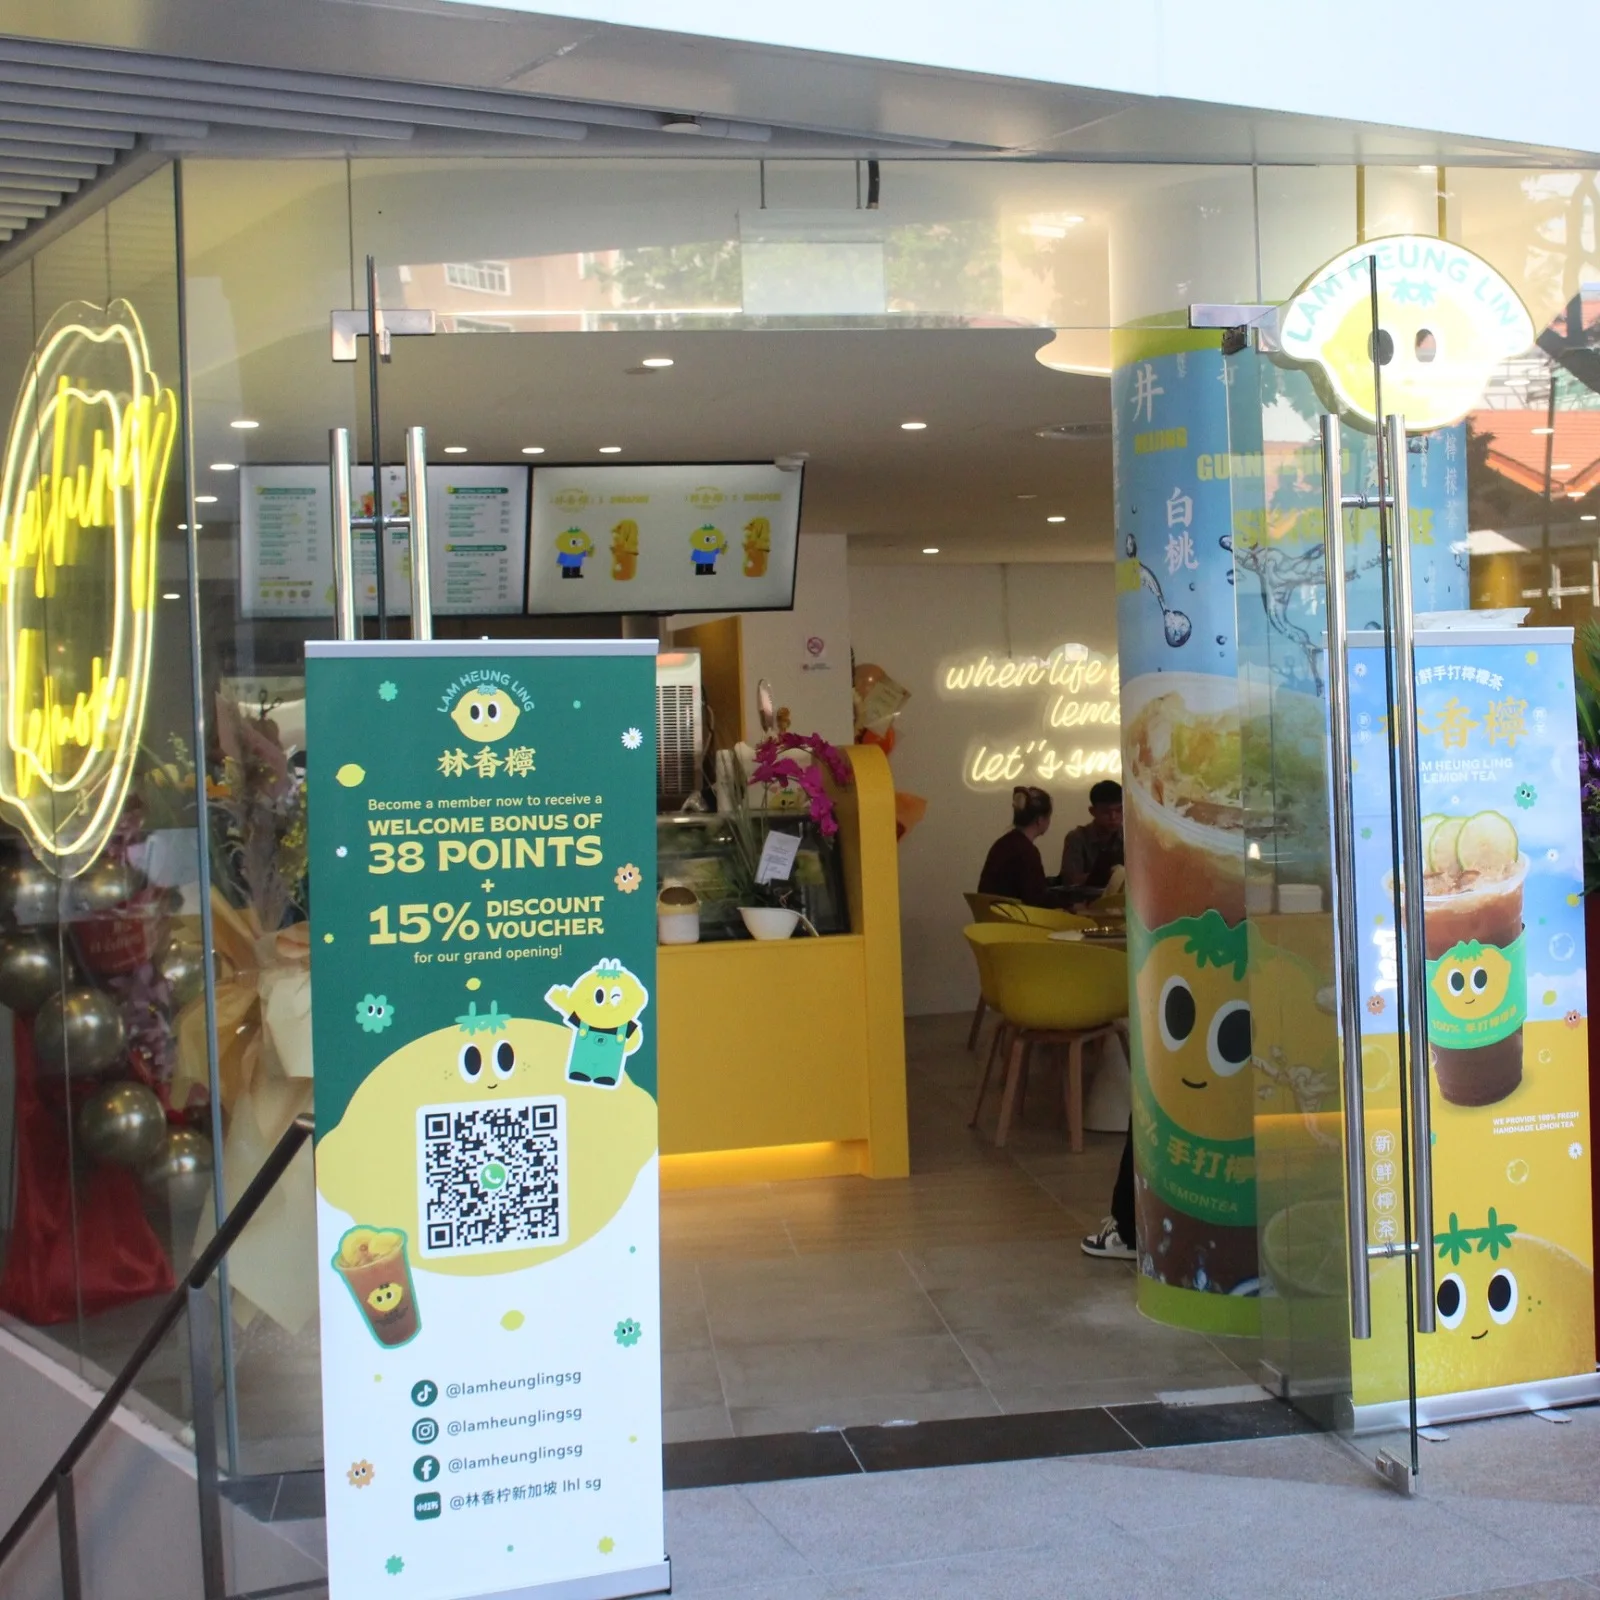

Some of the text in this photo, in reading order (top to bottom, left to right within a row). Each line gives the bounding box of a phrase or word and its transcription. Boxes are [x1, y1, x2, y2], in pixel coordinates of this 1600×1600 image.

[1286, 271, 1343, 342] LAM
[1348, 243, 1471, 284] HEUNG
[1164, 486, 1199, 575] 白桃
[945, 656, 1046, 690] when
[1048, 652, 1107, 694] life
[437, 670, 535, 712] LAM HEUNG LING
[437, 745, 536, 778] 林香檸
[1435, 759, 1480, 771] HEUNG
[1483, 757, 1512, 769] LING
[1423, 770, 1496, 784] LEMON TEA
[368, 794, 602, 811] Become a member now to receive a
[368, 813, 603, 836] WELCOME BONUS OF
[368, 835, 603, 874] 38 POINTS
[486, 896, 604, 917] DISCOUNT
[368, 902, 480, 945] 15%
[486, 918, 604, 939] VOUCHER
[414, 945, 562, 964] for our grand opening!
[1493, 1120, 1575, 1135] HANDMADE LEMON TEA
[1505, 1115, 1536, 1124] PROVIDE
[1557, 1111, 1579, 1120] FRESH
[445, 1369, 582, 1398] @lamheunglingsg
[447, 1407, 583, 1436] @lamheunglingsg
[448, 1443, 583, 1473] @lamheunglingsg
[585, 1477, 602, 1491] sg
